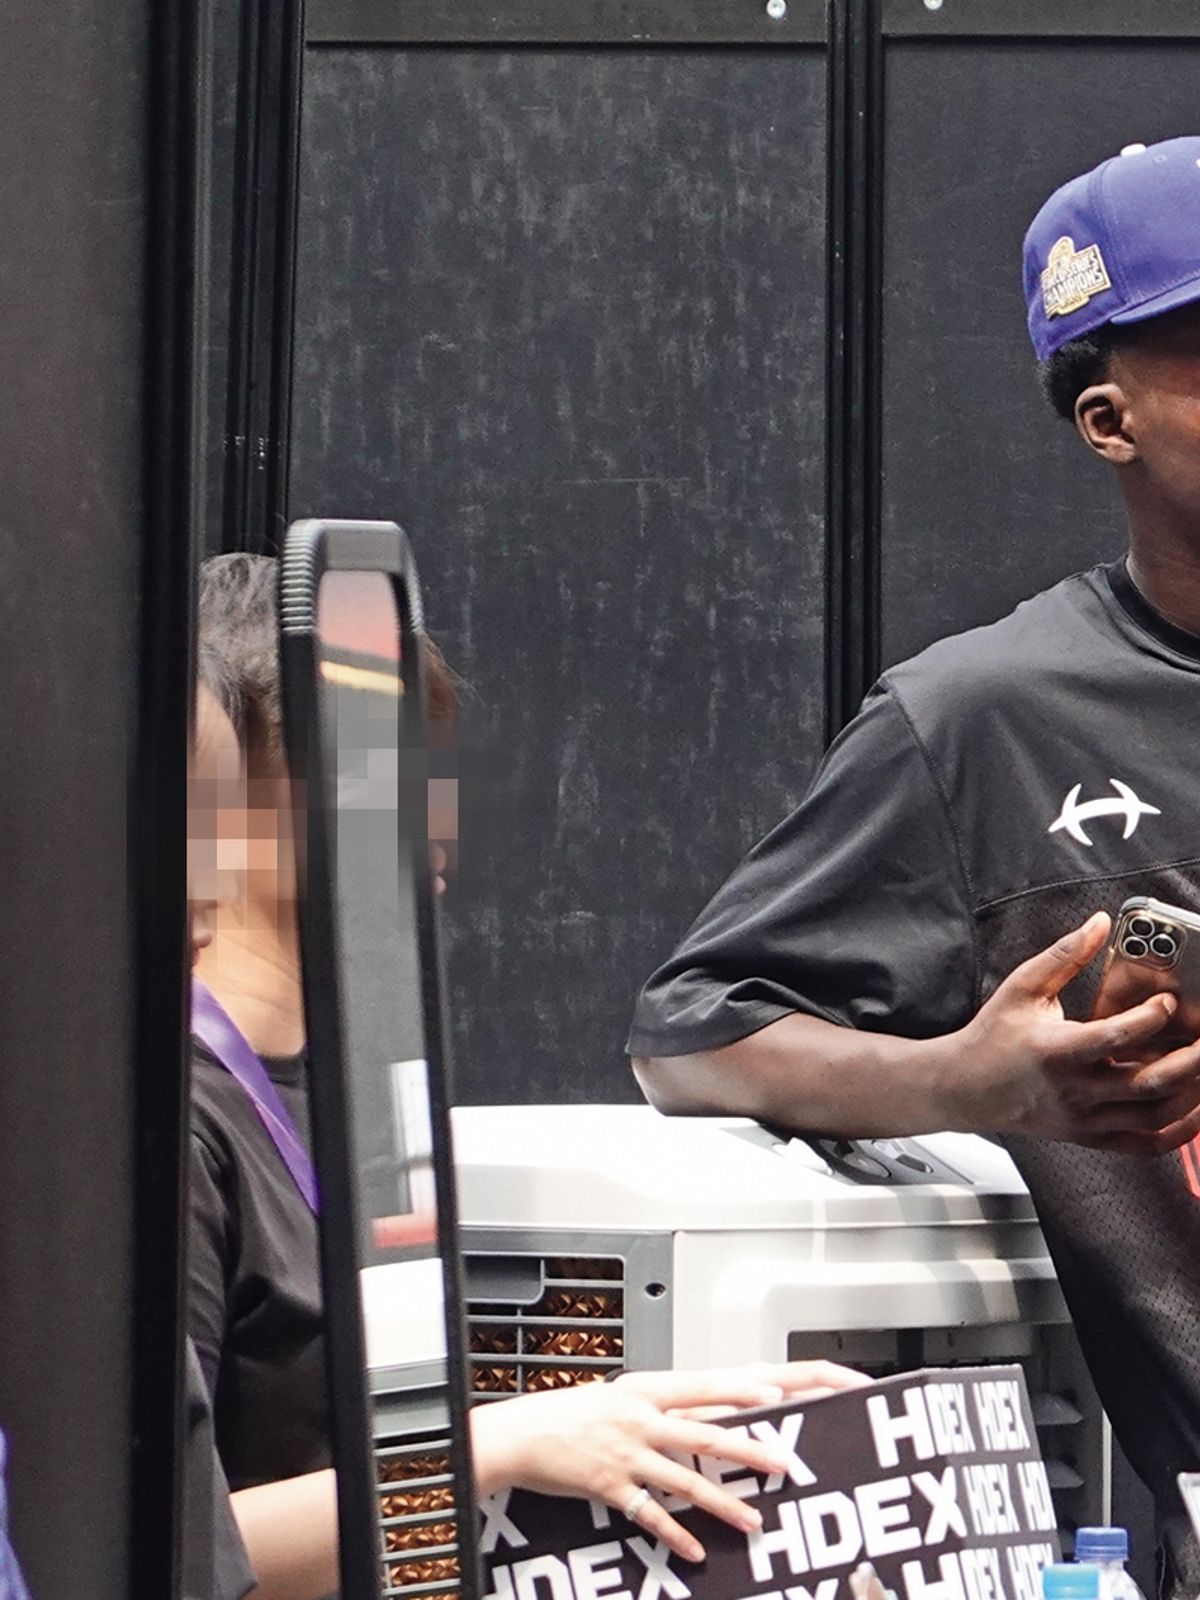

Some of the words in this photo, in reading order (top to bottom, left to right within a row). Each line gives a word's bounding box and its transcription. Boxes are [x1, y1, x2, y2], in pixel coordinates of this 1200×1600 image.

[973, 1380, 1031, 1451] HDEX
[747, 1466, 967, 1583] HDEX
[962, 1463, 1020, 1536] HDEX
[1017, 1461, 1057, 1531] HD
